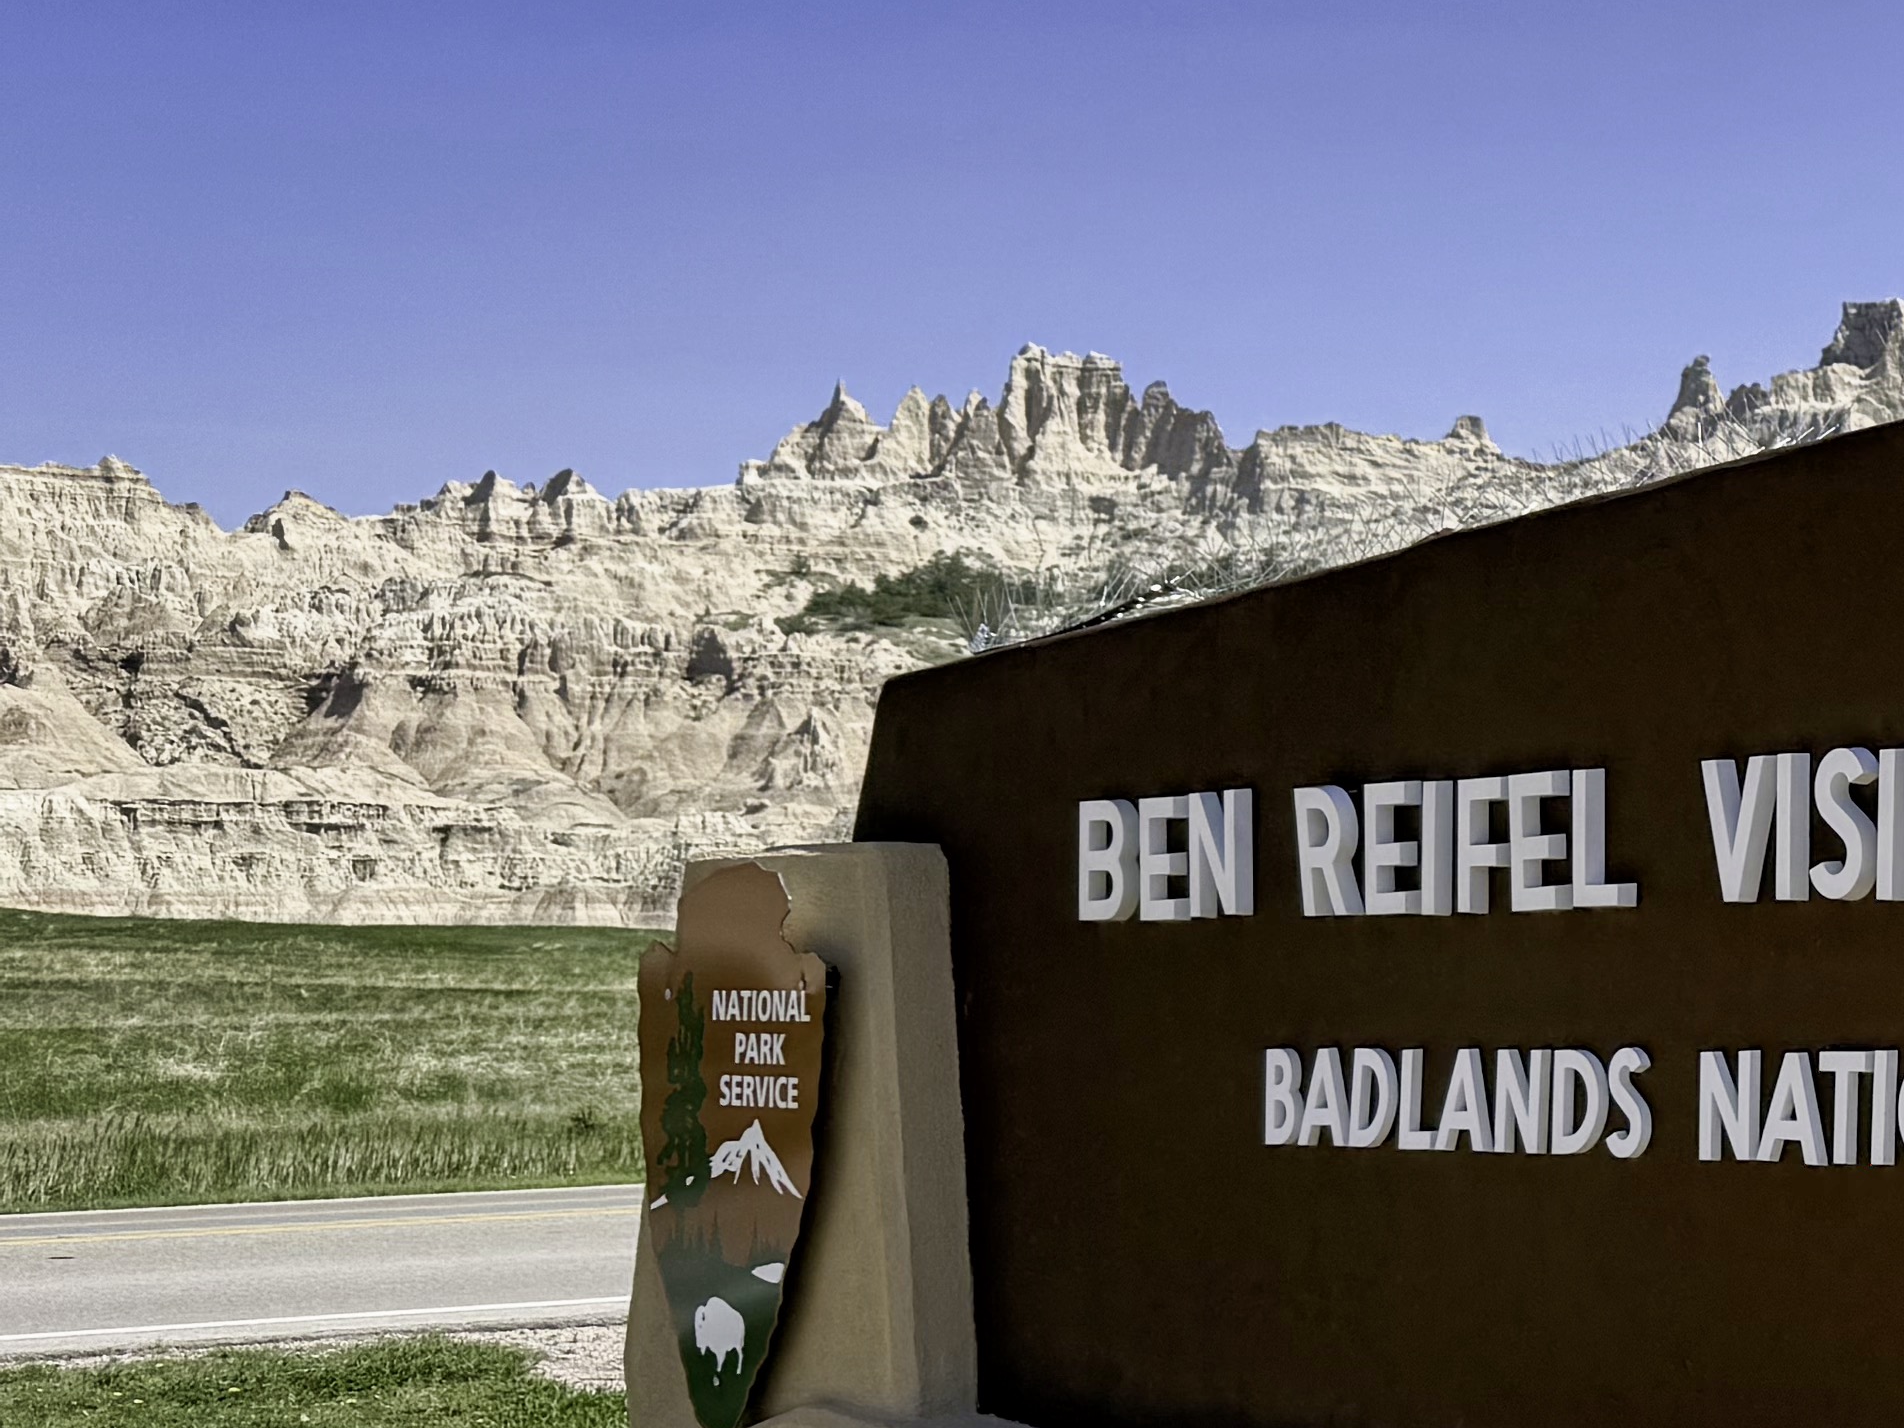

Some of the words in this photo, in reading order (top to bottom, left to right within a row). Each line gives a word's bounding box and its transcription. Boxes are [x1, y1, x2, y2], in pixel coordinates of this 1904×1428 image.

[1079, 788, 1253, 921] BEN
[1294, 768, 1638, 917] REIFEL
[712, 989, 811, 1022] NATIONAL
[734, 1033, 785, 1065] PARK
[719, 1074, 799, 1109] SERVICE
[1264, 1047, 1652, 1159] BADLANDS
